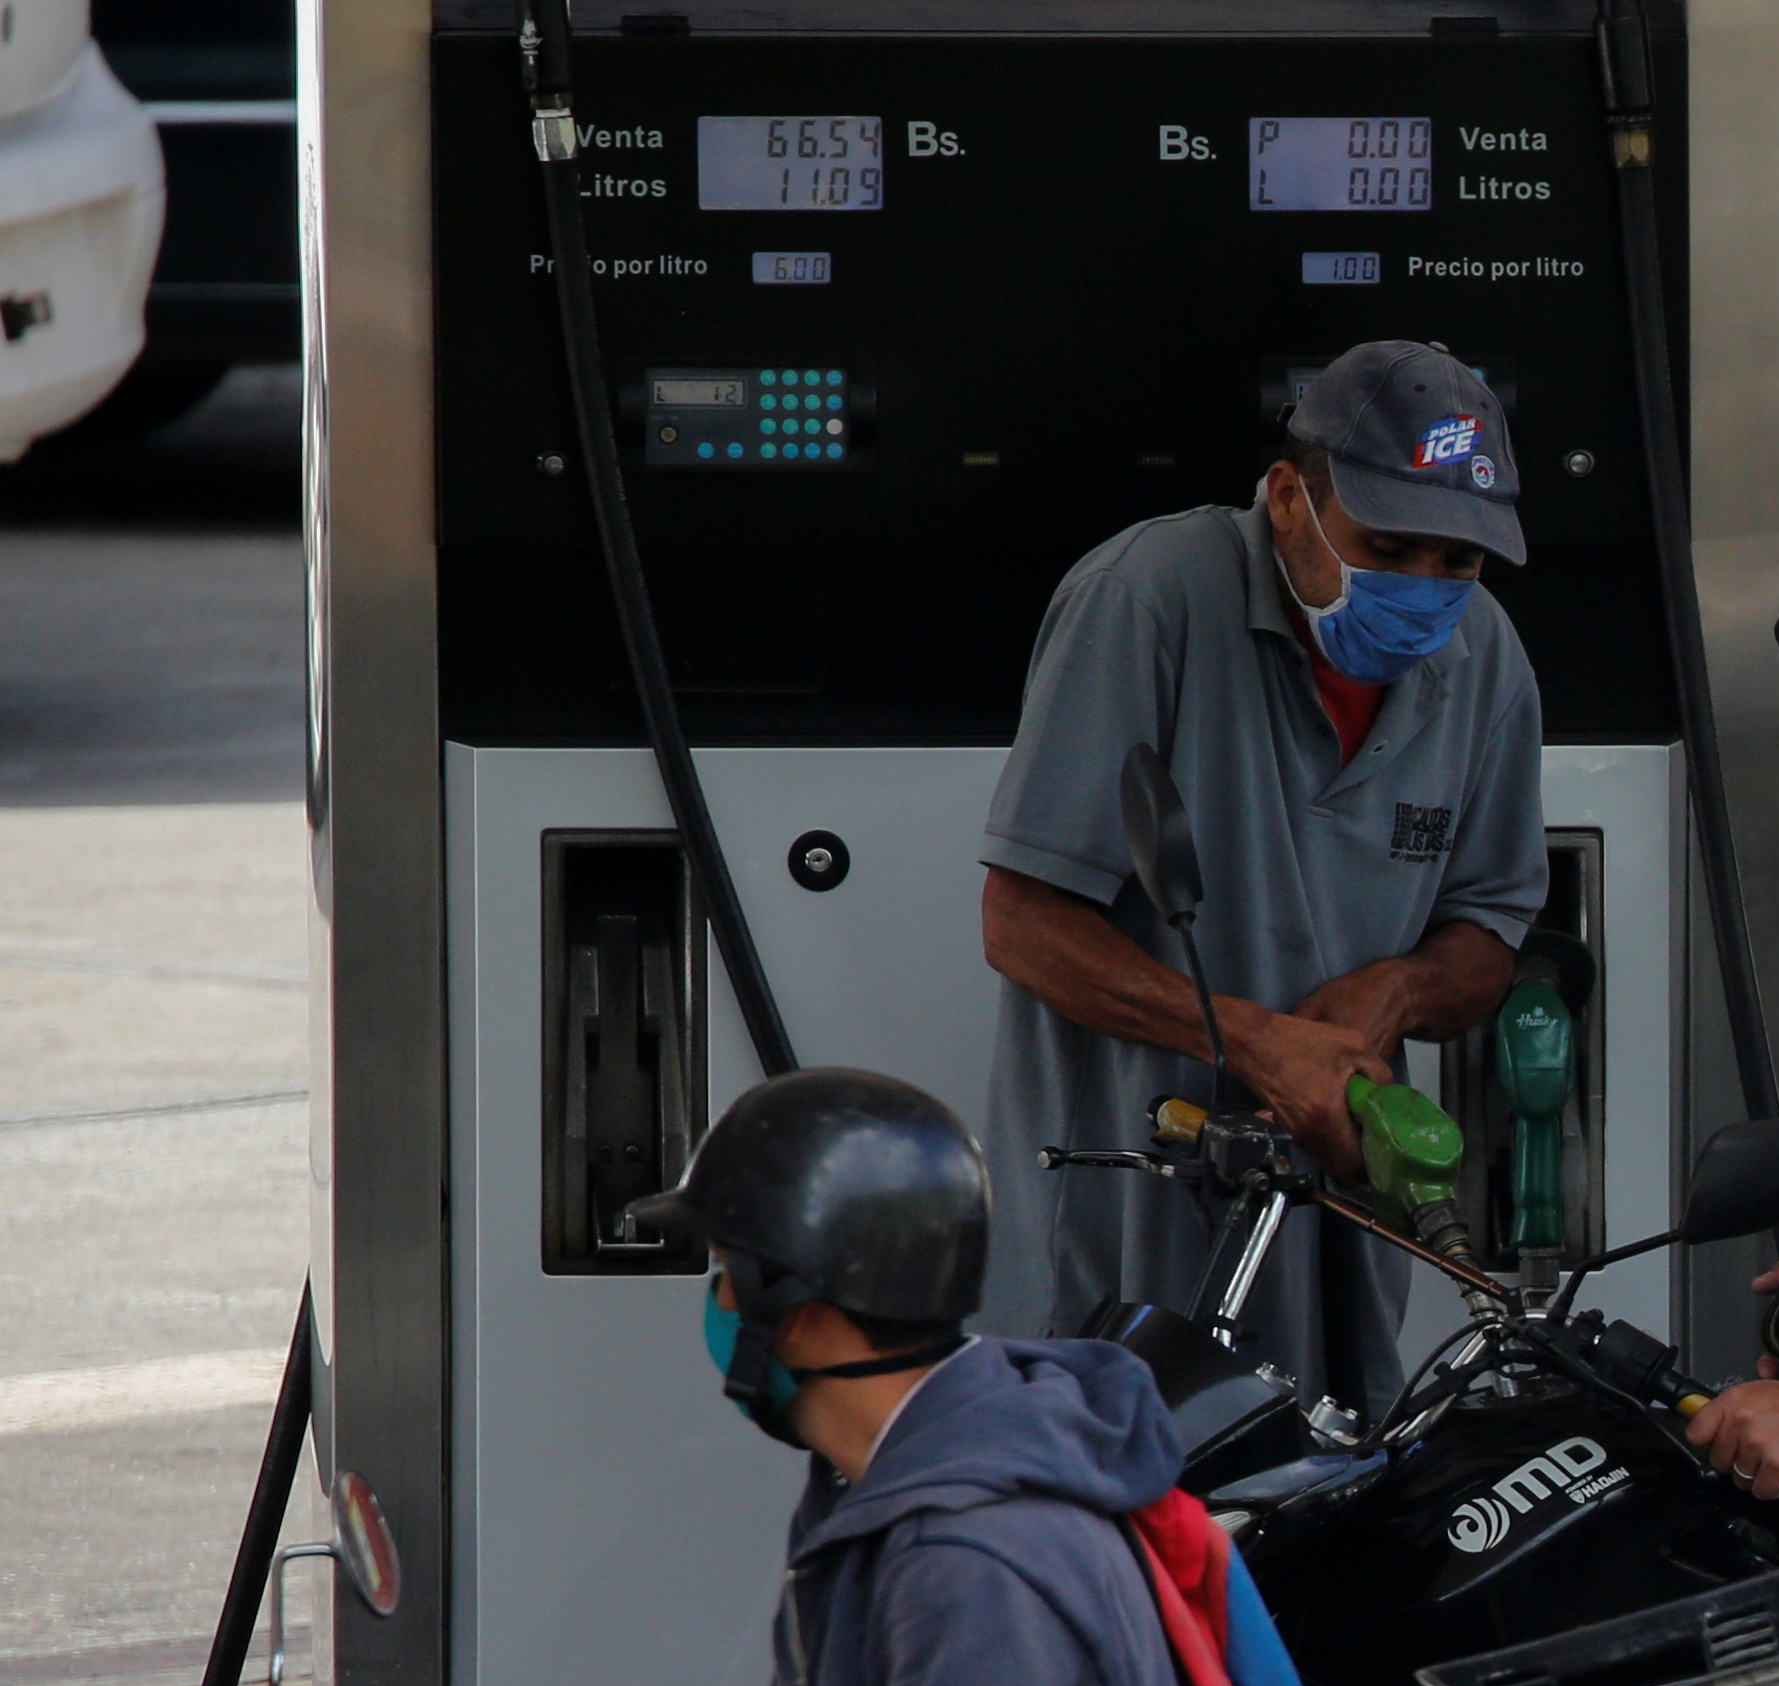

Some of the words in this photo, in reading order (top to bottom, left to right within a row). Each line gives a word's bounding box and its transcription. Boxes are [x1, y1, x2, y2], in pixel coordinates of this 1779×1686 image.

[574, 124, 664, 149] Venta
[907, 121, 967, 156] Bs.
[1159, 125, 1217, 160] Bs.
[1347, 120, 1431, 158] 0.00
[1459, 127, 1548, 151] Venta
[1347, 167, 1431, 206] 0.00
[1459, 176, 1551, 200] Litros
[613, 259, 654, 279] por
[660, 255, 708, 274] litro
[773, 256, 827, 281] 6.00
[1333, 256, 1376, 281] 1.00
[1408, 256, 1484, 276] Precio
[1491, 260, 1530, 281] por
[1536, 256, 1584, 276] litro
[1421, 430, 1475, 464] ICE
